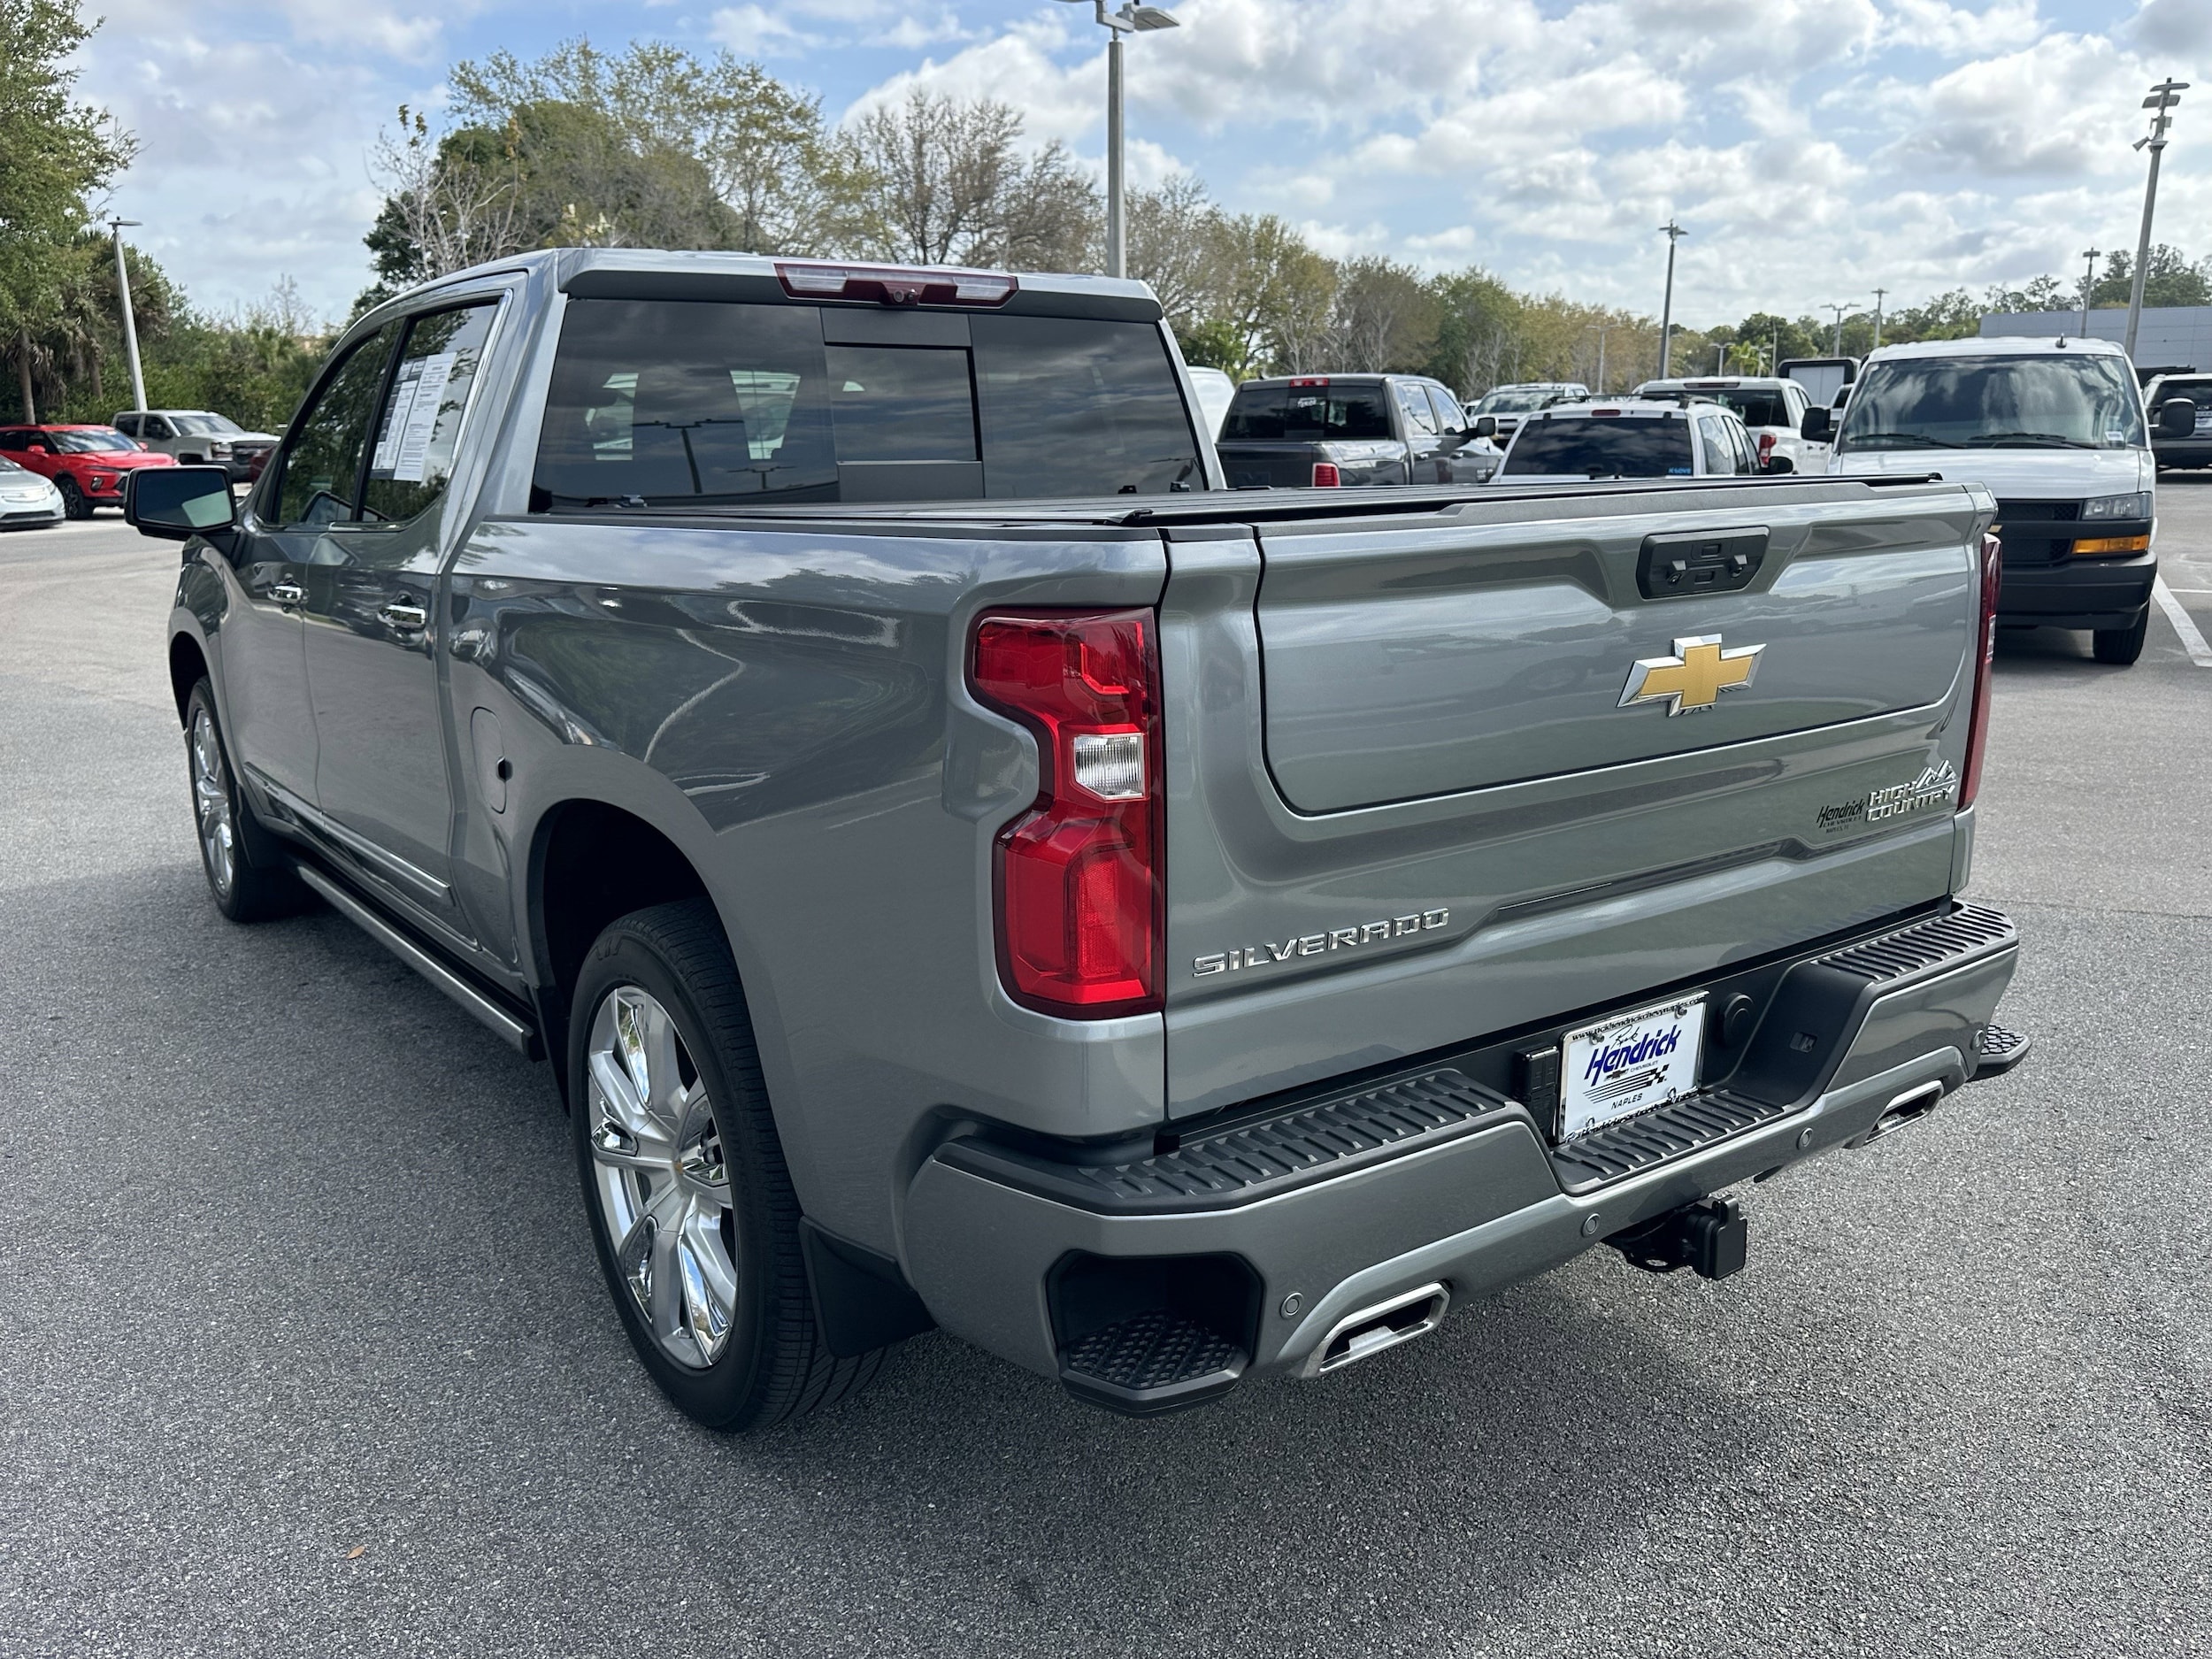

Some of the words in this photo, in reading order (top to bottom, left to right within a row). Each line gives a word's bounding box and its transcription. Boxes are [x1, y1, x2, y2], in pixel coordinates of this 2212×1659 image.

[1865, 784, 1955, 822] COUNTRY
[1869, 780, 1917, 807] HIGH
[1816, 798, 1865, 829] Hendrick
[1193, 907, 1448, 977] SILVERADO
[1584, 1024, 1682, 1087] Hendrick
[1631, 1060, 1659, 1073] CHEVROLET
[1610, 1093, 1643, 1110] NAPLES
